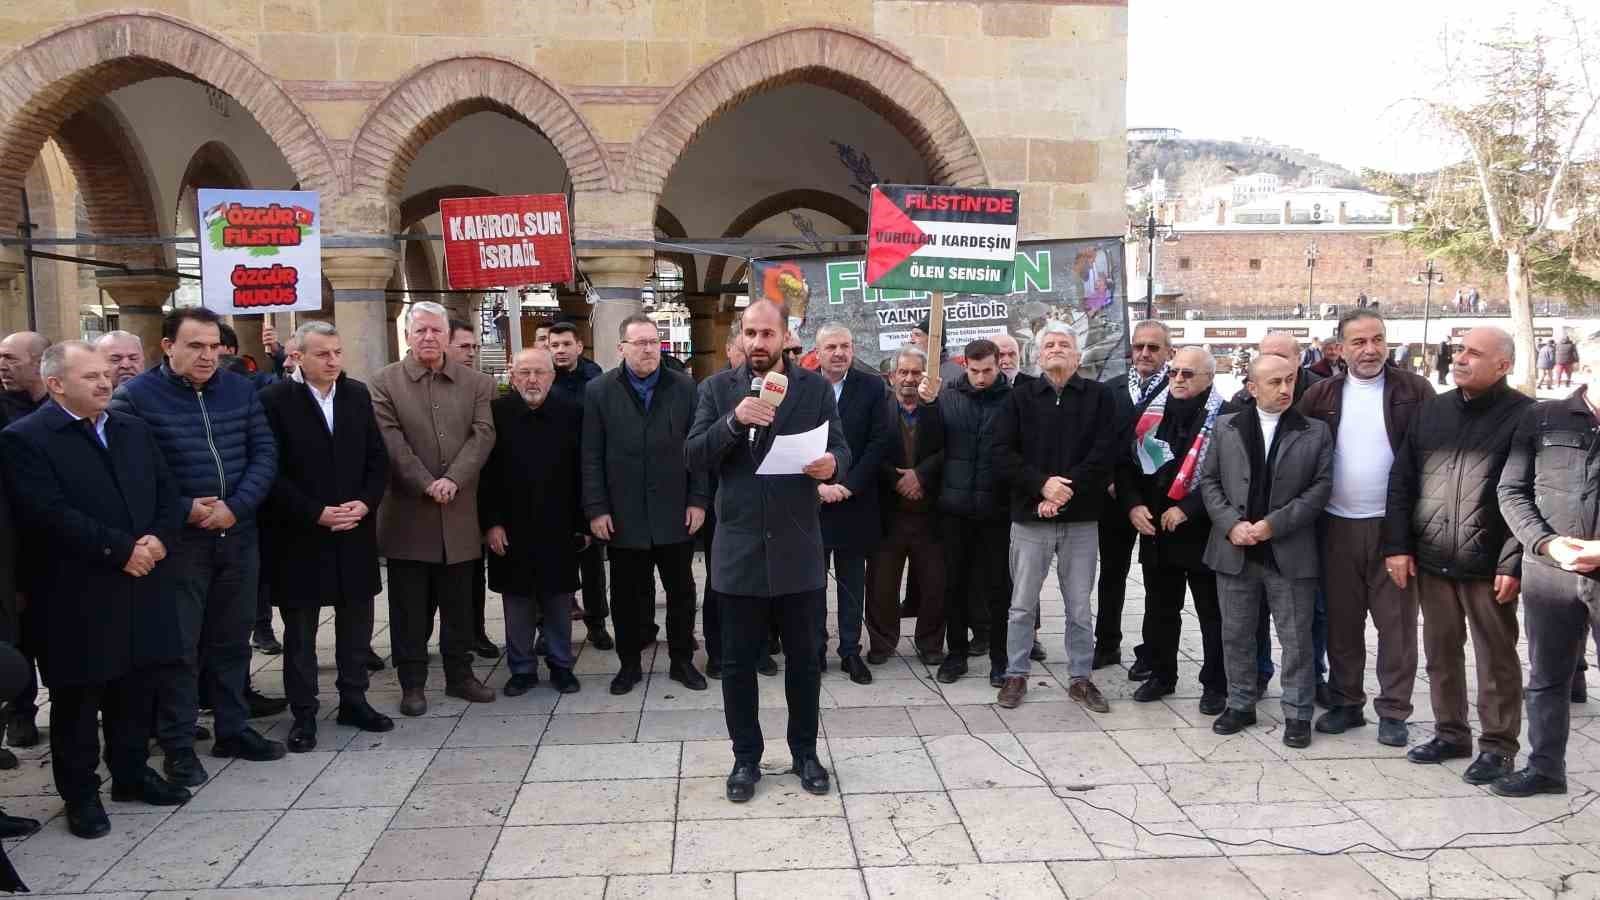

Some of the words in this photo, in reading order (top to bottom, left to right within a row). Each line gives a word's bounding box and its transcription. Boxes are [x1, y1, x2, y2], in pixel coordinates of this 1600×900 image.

[227, 203, 297, 226] ÖZGÜR
[450, 211, 562, 240] KAHROLSUN
[876, 231, 937, 246] VURULAN
[942, 233, 1011, 253] KARDEŞİN
[479, 239, 540, 269] İSRAİL
[231, 264, 298, 287] ÖZGÜR
[910, 261, 944, 279] ÖLEN
[943, 301, 1006, 320] EĞİLDİR
